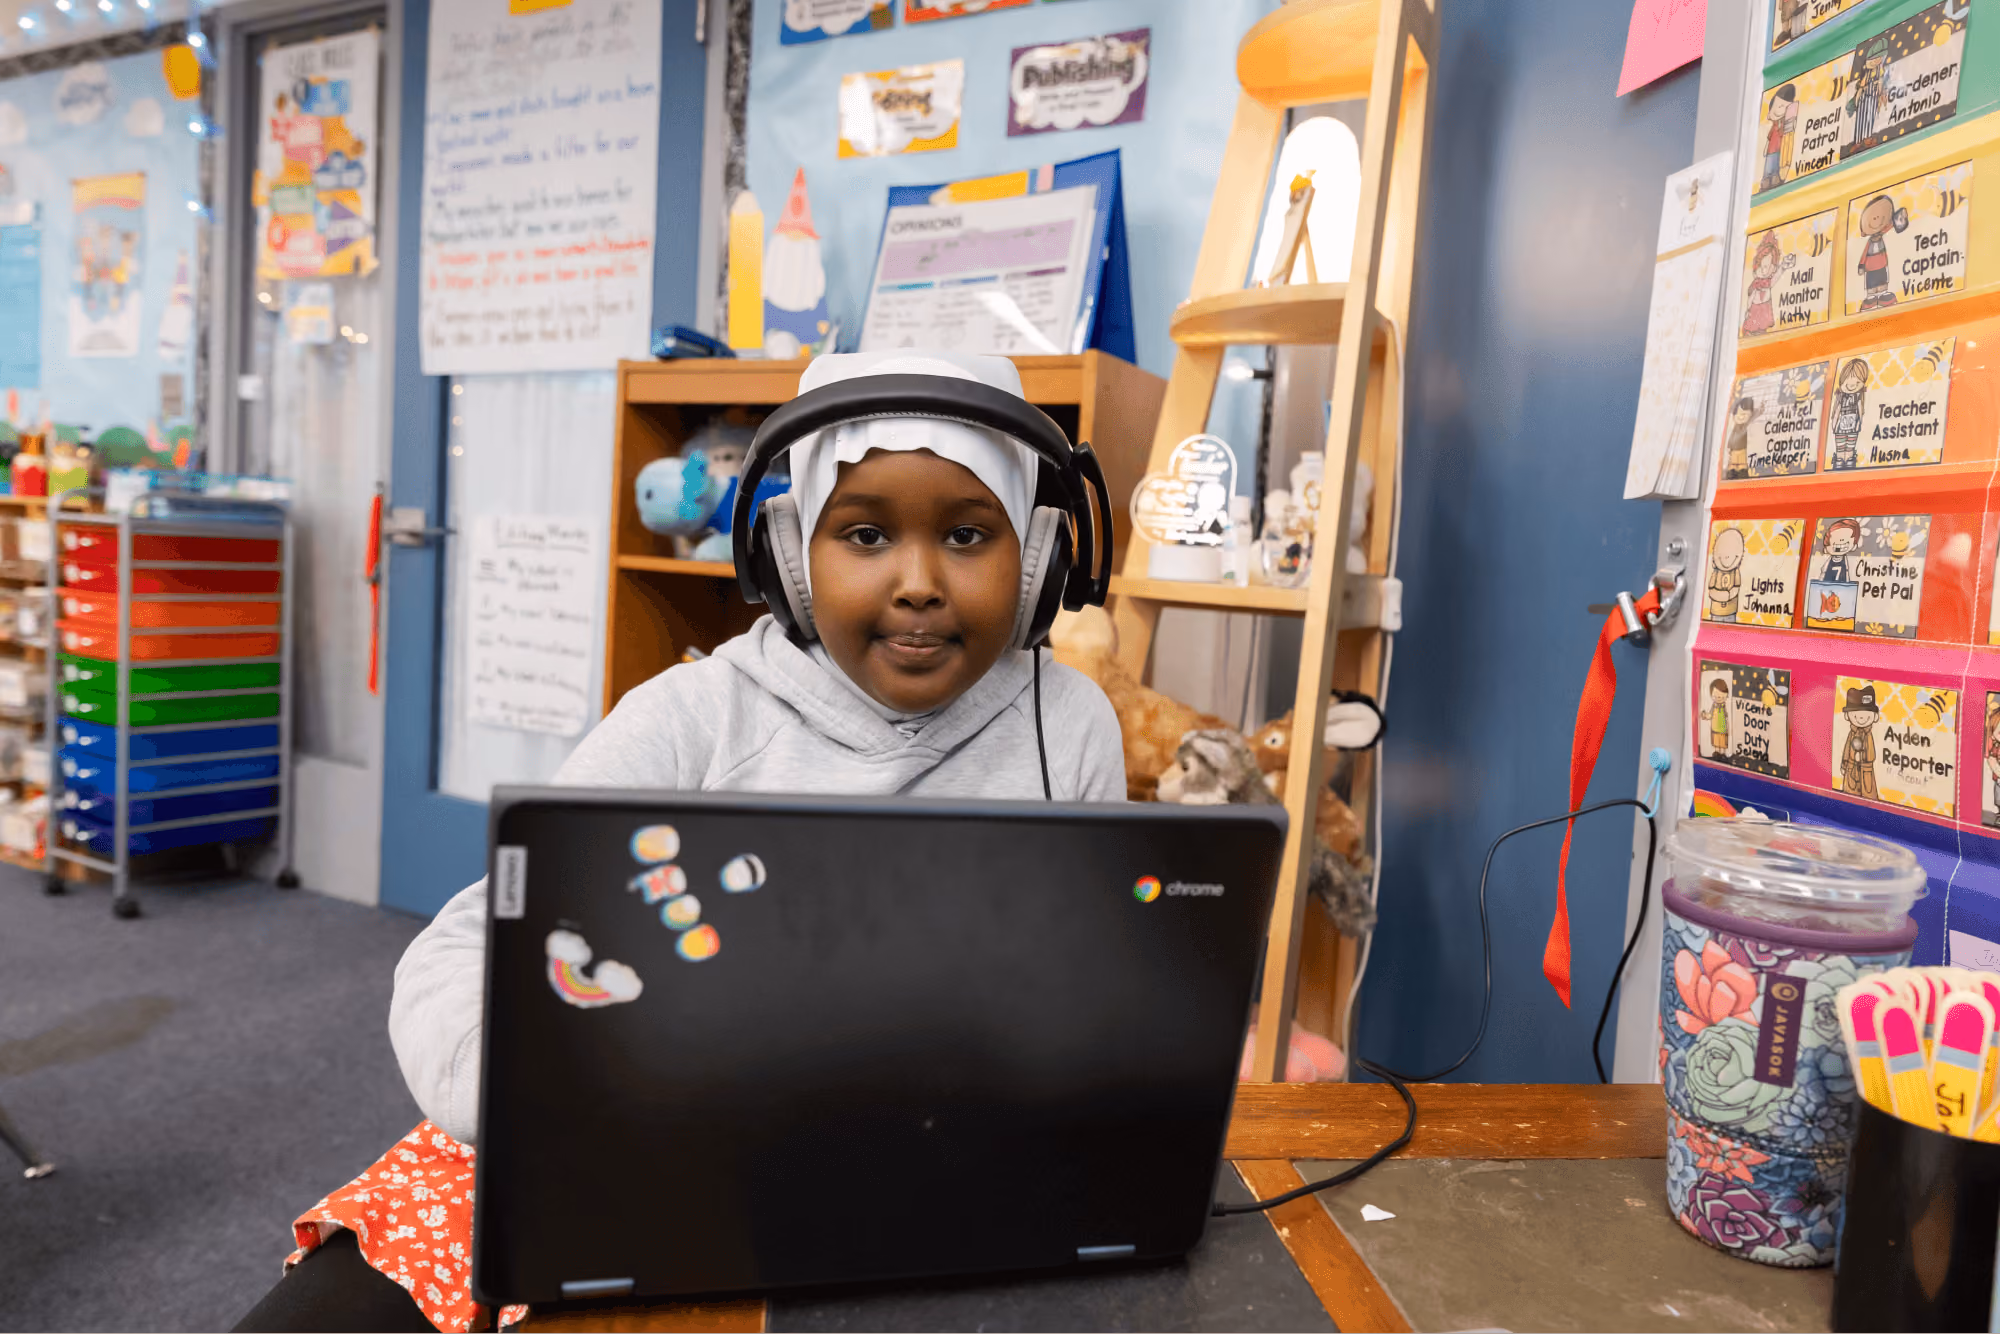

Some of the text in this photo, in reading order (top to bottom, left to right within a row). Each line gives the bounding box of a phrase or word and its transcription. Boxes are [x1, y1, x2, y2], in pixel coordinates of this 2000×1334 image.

[1023, 54, 1135, 89] Publishing
[1888, 88, 1941, 125] Antonio
[1805, 107, 1841, 134] Pencil
[1801, 127, 1839, 153] Patrol
[1795, 148, 1835, 176] Vincent
[890, 216, 963, 235] OPINIONS
[1914, 228, 1948, 251] Tech
[1790, 267, 1814, 286] Mail
[1902, 272, 1953, 296] Vicente
[1779, 287, 1823, 307] Monitor
[1779, 305, 1811, 326] Kathy
[1879, 400, 1936, 419] Teacher
[1764, 417, 1817, 435] Calendar
[1872, 418, 1939, 440] Assistant
[1767, 435, 1811, 455] Captain
[1870, 446, 1910, 463] Husna
[1831, 566, 1842, 580] 7
[1855, 559, 1918, 580] Christine
[1751, 577, 1784, 595] Lights
[1862, 581, 1914, 600] Pet Pal
[1743, 593, 1793, 615] Johanna
[1736, 699, 1773, 716] Vicente
[1743, 713, 1770, 731] Door
[1744, 731, 1770, 752] Duty
[1884, 726, 1931, 750] Ayden
[1882, 748, 1954, 777] Reporter
[1165, 880, 1225, 896] chrome
[1768, 1005, 1789, 1077] JAVASOK
